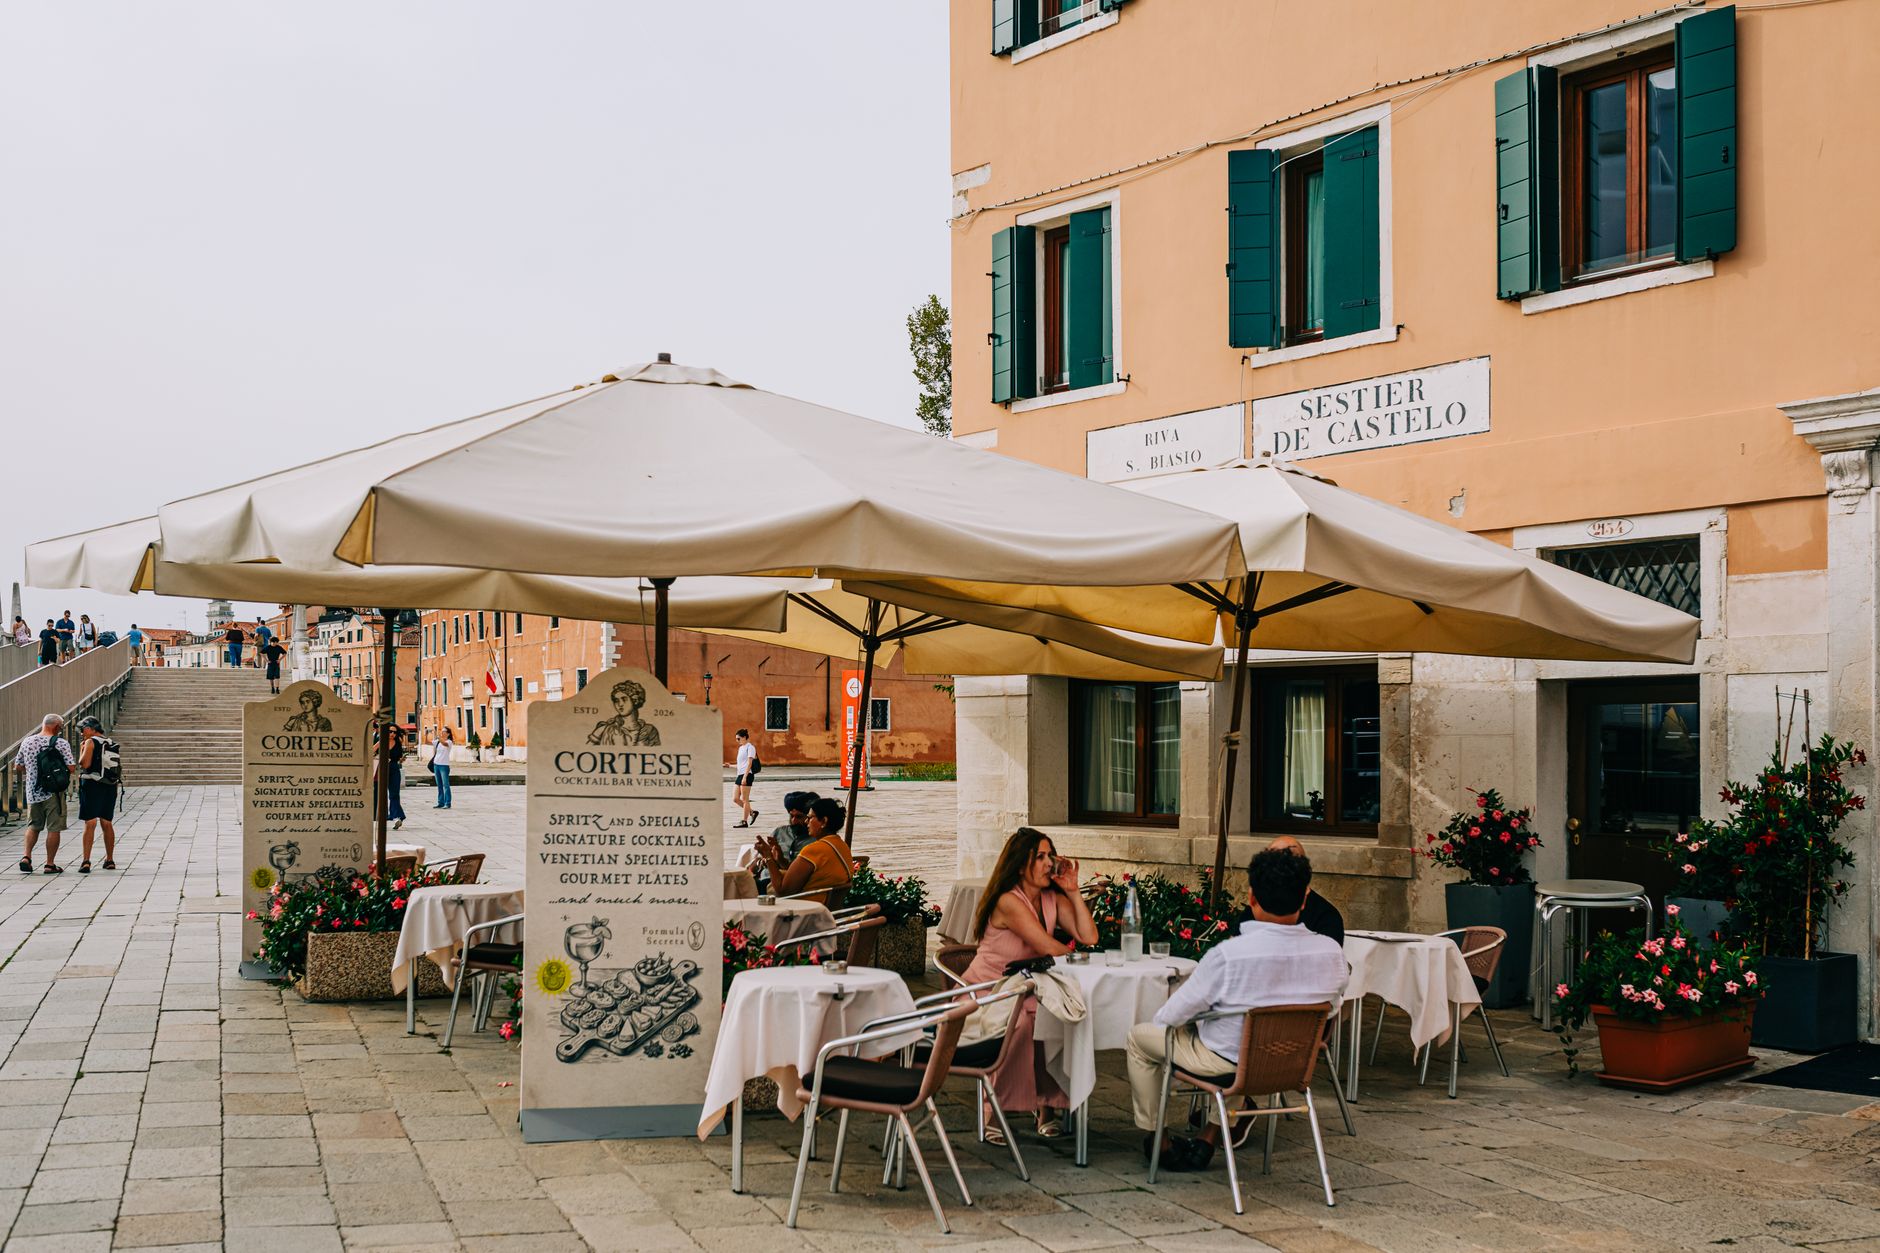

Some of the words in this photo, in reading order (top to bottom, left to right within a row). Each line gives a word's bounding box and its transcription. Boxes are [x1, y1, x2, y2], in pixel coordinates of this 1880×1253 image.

[1300, 378, 1424, 421] SESTIER
[1273, 427, 1310, 454] DE
[1327, 401, 1467, 444] CASTELO
[1145, 428, 1179, 446] RIVA
[1126, 460, 1140, 473] S.
[1151, 449, 1201, 469] BIASIO
[573, 706, 599, 715] ESTD
[653, 709, 674, 717] 2026
[261, 735, 353, 751] CORTESE
[554, 751, 692, 776] CORTESE
[258, 775, 298, 786] SPRITZ
[318, 776, 358, 784] SPECIALS
[554, 776, 609, 785] COCKTAIL
[612, 777, 633, 786] BAR
[636, 778, 692, 787] VENEXIAN
[254, 788, 310, 796] SIGNATURE
[312, 788, 362, 796] COCKTAILS
[252, 800, 306, 808] VENETIAN
[308, 801, 364, 809] SPECIALTIES
[266, 812, 314, 820] GOURMET
[317, 812, 351, 821] PLATES
[549, 814, 610, 831] SPRITZ
[610, 817, 633, 826] AND
[638, 816, 700, 827] SPECIALS
[289, 826, 321, 834] much
[542, 833, 626, 846] SIGNATURE
[632, 835, 705, 847] COCKTAILS
[540, 853, 619, 865] VENETIAN
[624, 854, 709, 866] SPECIALTIES
[559, 873, 632, 885] GOURMET
[637, 874, 688, 885] PLATES
[594, 894, 643, 904] much
[642, 926, 684, 935] Formula
